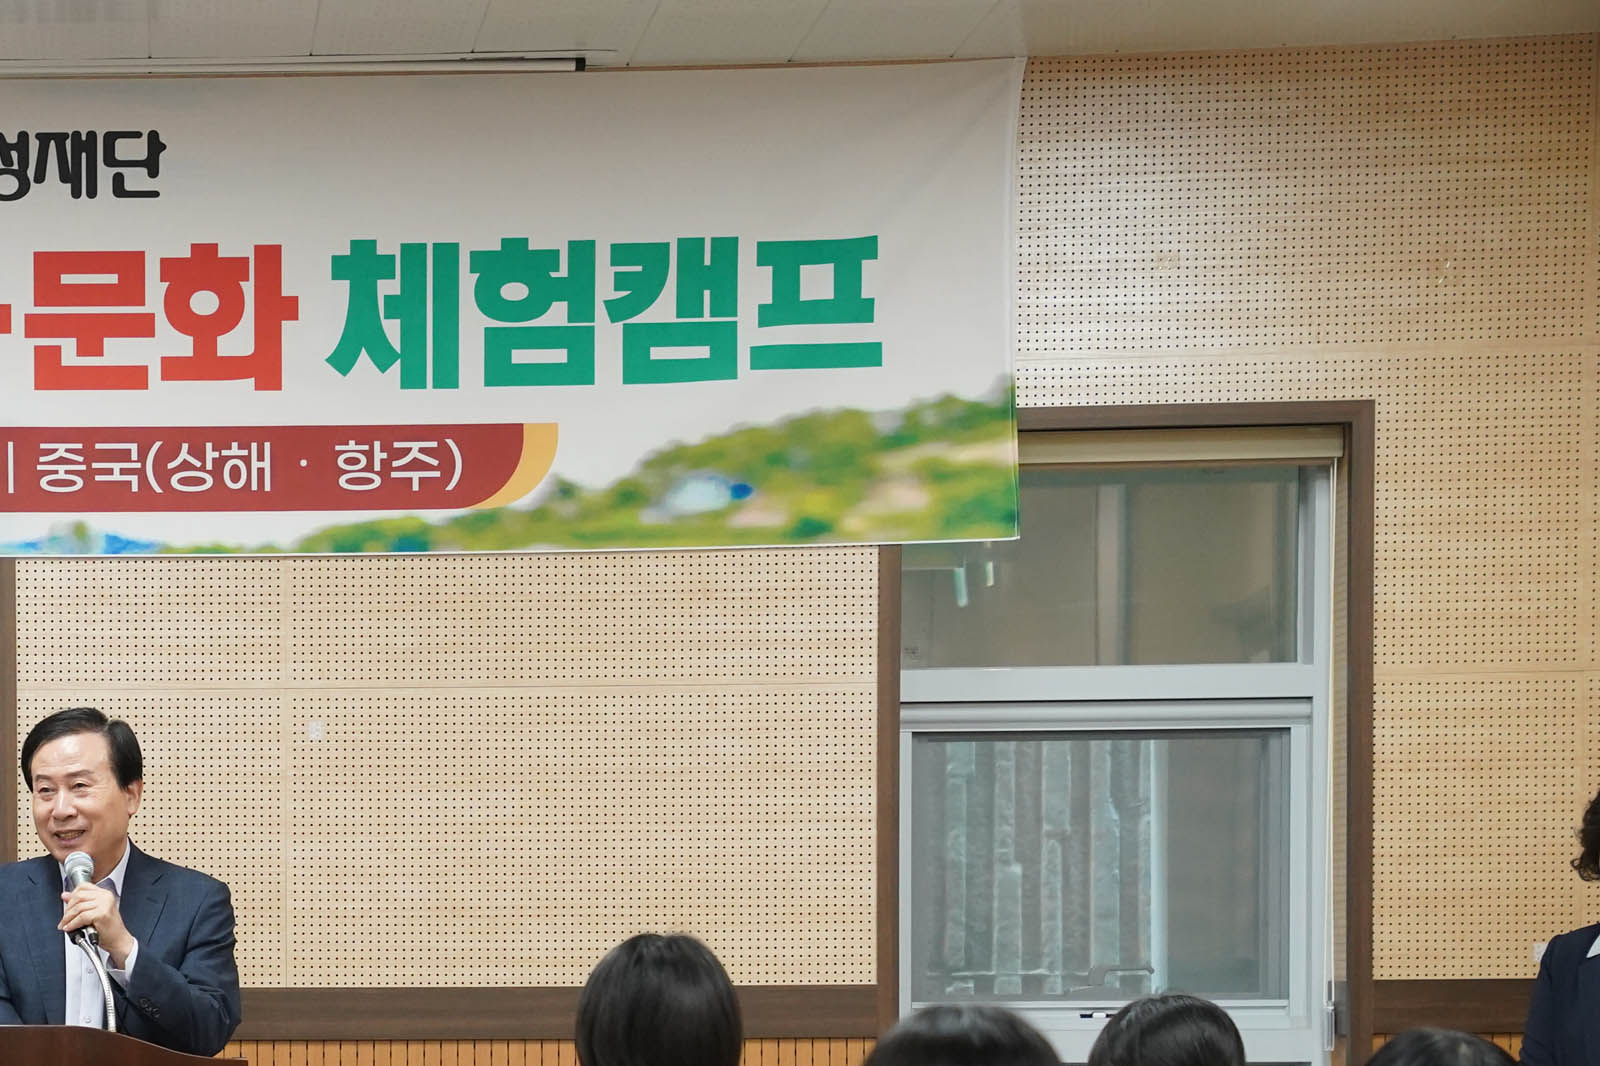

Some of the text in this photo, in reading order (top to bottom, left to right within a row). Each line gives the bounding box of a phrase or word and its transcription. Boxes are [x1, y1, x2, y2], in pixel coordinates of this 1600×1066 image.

[325, 234, 883, 390] 체험캠프
[36, 440, 271, 494] 중국(상해
[334, 438, 464, 492] 항주)
